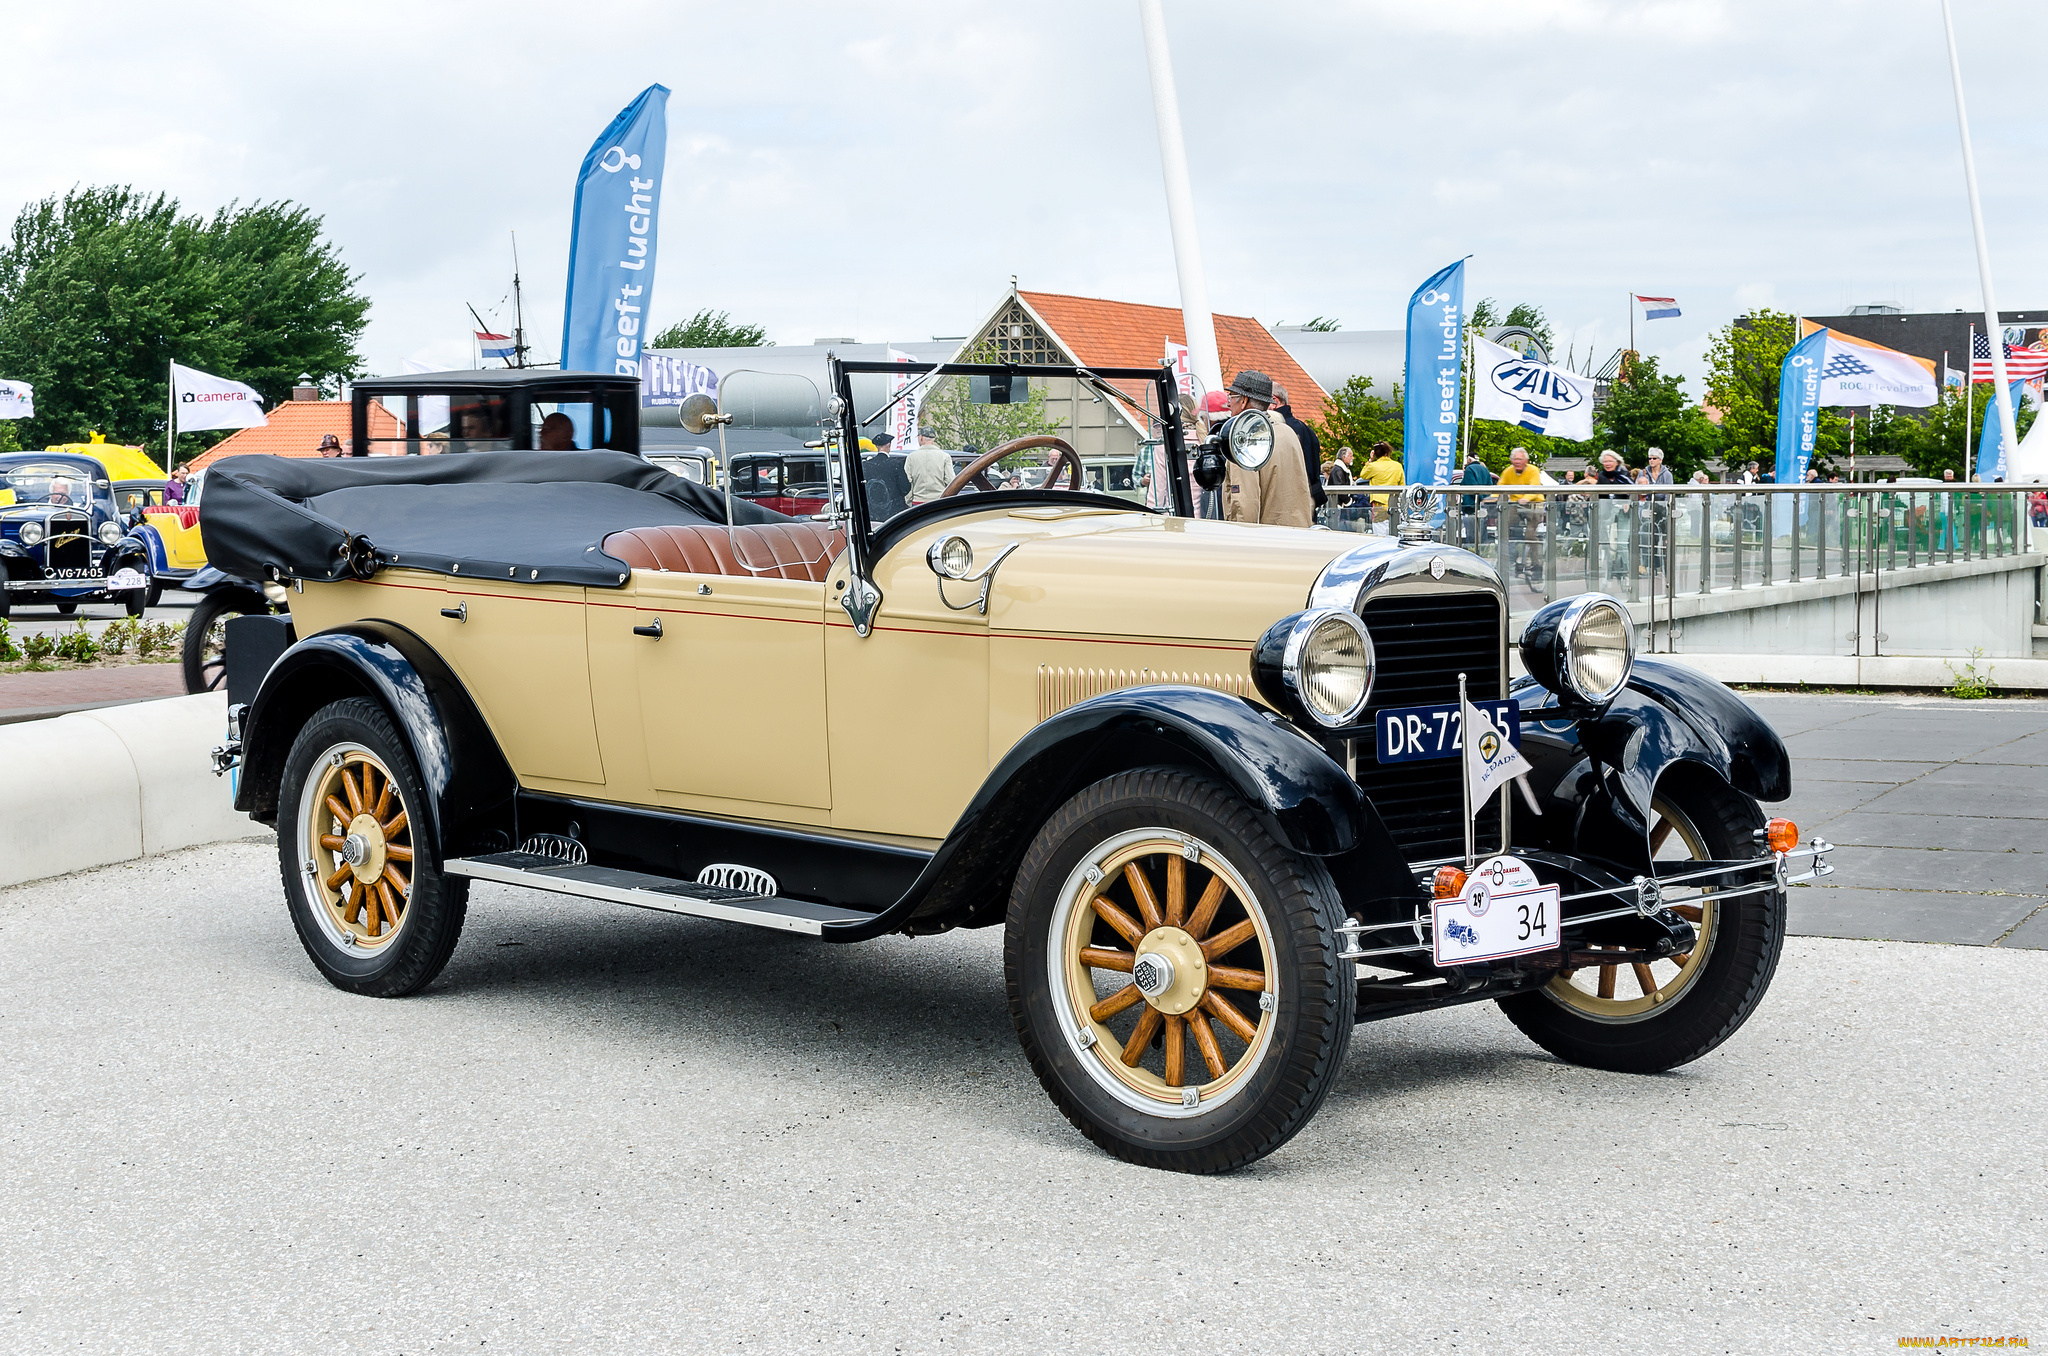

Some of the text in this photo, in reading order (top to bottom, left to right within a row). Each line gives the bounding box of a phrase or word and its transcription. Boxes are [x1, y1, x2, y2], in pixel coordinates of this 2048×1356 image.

[615, 176, 653, 376] geeft lucht
[1438, 304, 1458, 360] lucht
[651, 356, 709, 394] FLEVO
[1498, 366, 1571, 403] FAIR
[1803, 367, 1818, 406] lucht
[1840, 382, 1924, 393] ROC Flevoland
[1437, 368, 1456, 424] geeft
[1801, 410, 1815, 451] geeft
[58, 567, 104, 578] VG-74-05
[126, 577, 142, 586] 228
[1492, 860, 1504, 886] 8
[1517, 901, 1547, 941] 34
[1135, 965, 1150, 990] ESSEX
